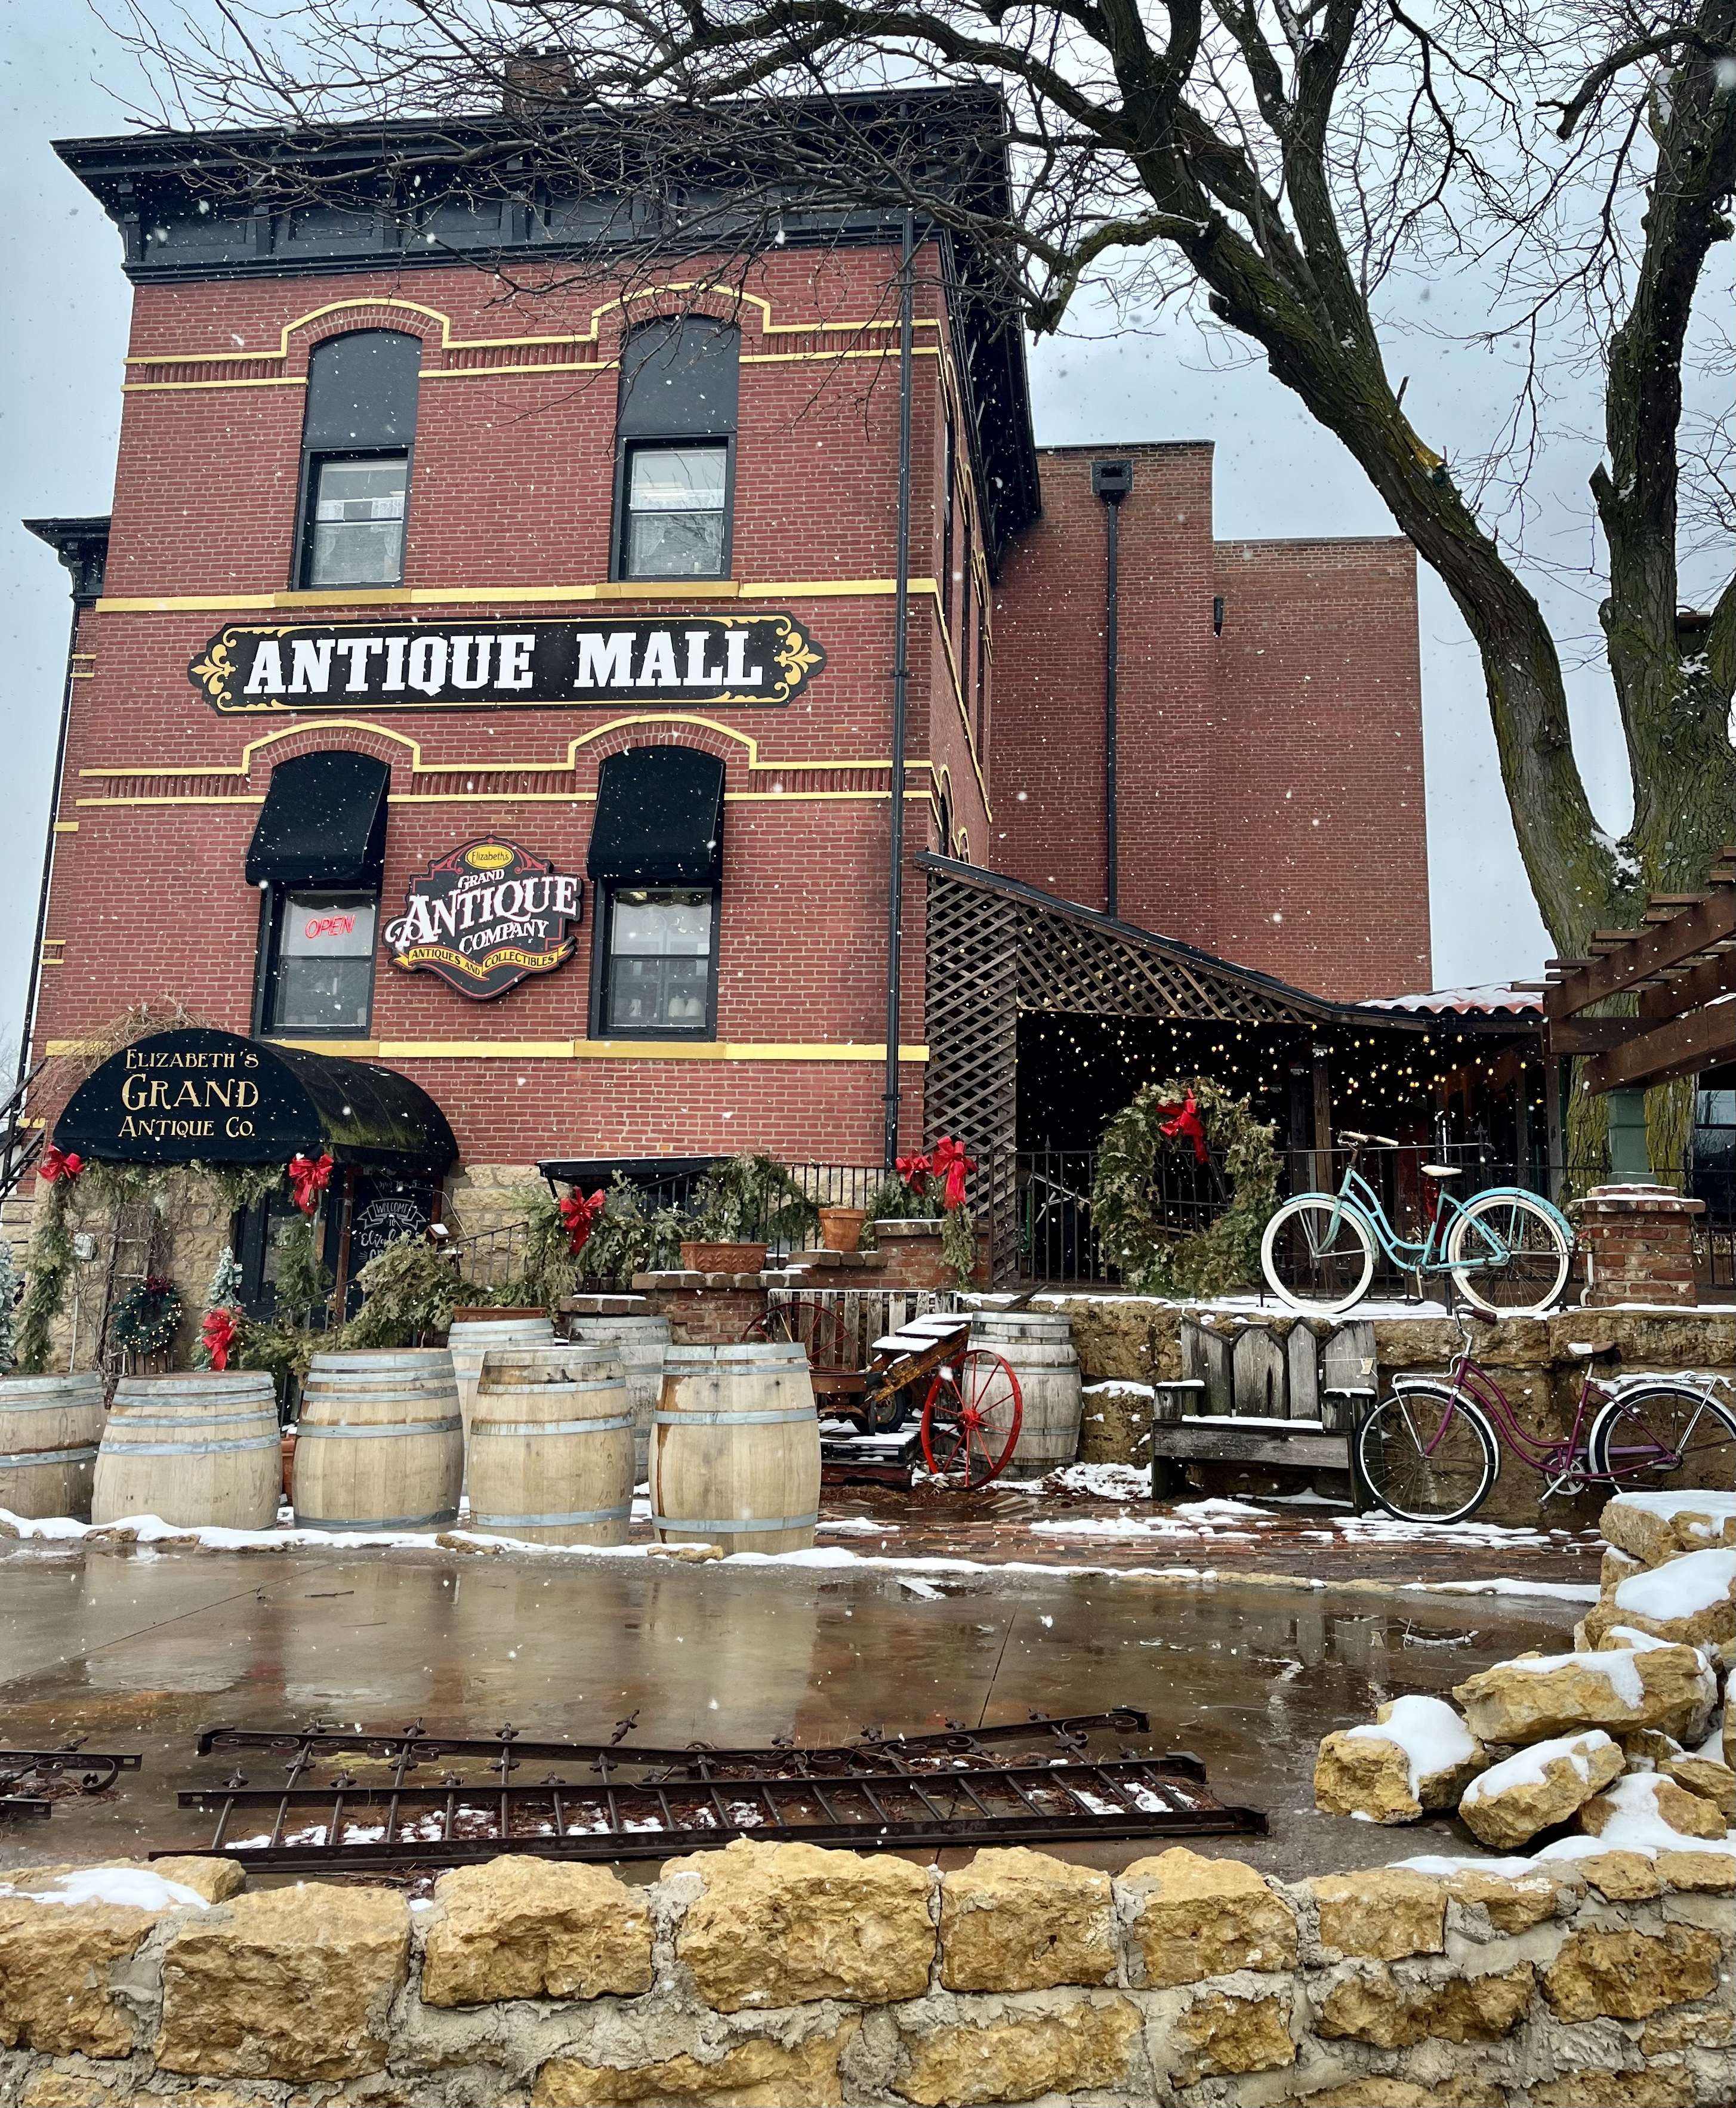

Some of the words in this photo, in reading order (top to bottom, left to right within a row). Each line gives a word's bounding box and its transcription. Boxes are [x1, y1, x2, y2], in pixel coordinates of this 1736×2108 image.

[243, 634, 536, 697] ANTIQUE
[573, 630, 763, 688] MALL
[471, 850, 509, 864] Elizabeth's
[458, 869, 505, 891] GRAND
[385, 876, 578, 947] ANTIQUE
[305, 914, 356, 940] OPEN
[458, 919, 550, 955] COMPANY
[411, 948, 462, 965] ANTIQUES
[464, 962, 481, 976] AND
[484, 951, 555, 970] COLLECTIBLES
[125, 1048, 259, 1070] ELIZABETH'S
[121, 1073, 260, 1111] GRAND
[118, 1115, 215, 1138] ANTIQUE
